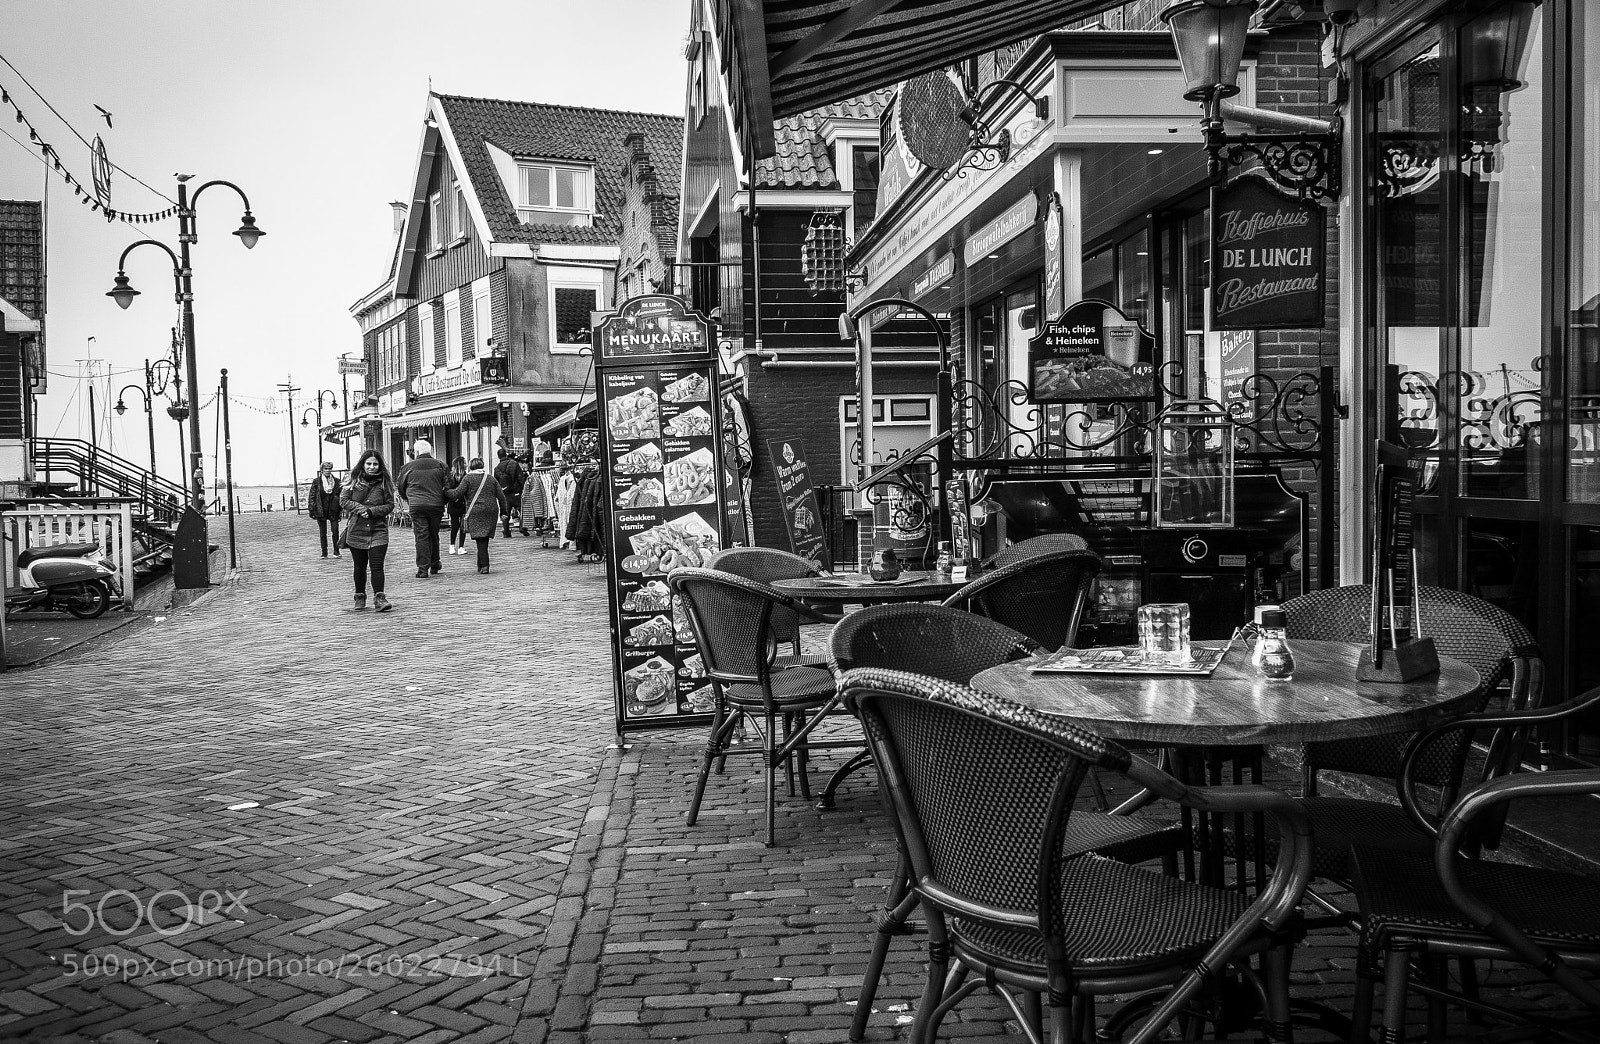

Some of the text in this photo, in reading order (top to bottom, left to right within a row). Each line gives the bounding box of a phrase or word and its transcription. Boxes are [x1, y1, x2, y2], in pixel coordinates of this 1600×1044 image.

[1217, 207, 1309, 243] Koffiehuis
[1223, 247, 1312, 268] DE LUNCH
[1217, 272, 1319, 313] Restaurant
[1049, 325, 1096, 334] Fish, chips
[609, 331, 700, 346] MENUKAART
[1045, 336, 1099, 345] & Heineken
[1221, 331, 1252, 357] Bakery
[1133, 366, 1152, 376] 14,95
[619, 514, 656, 523] Gebakken
[620, 523, 645, 531] vismix
[623, 560, 648, 570] €14,50
[625, 650, 656, 658] Grillburger
